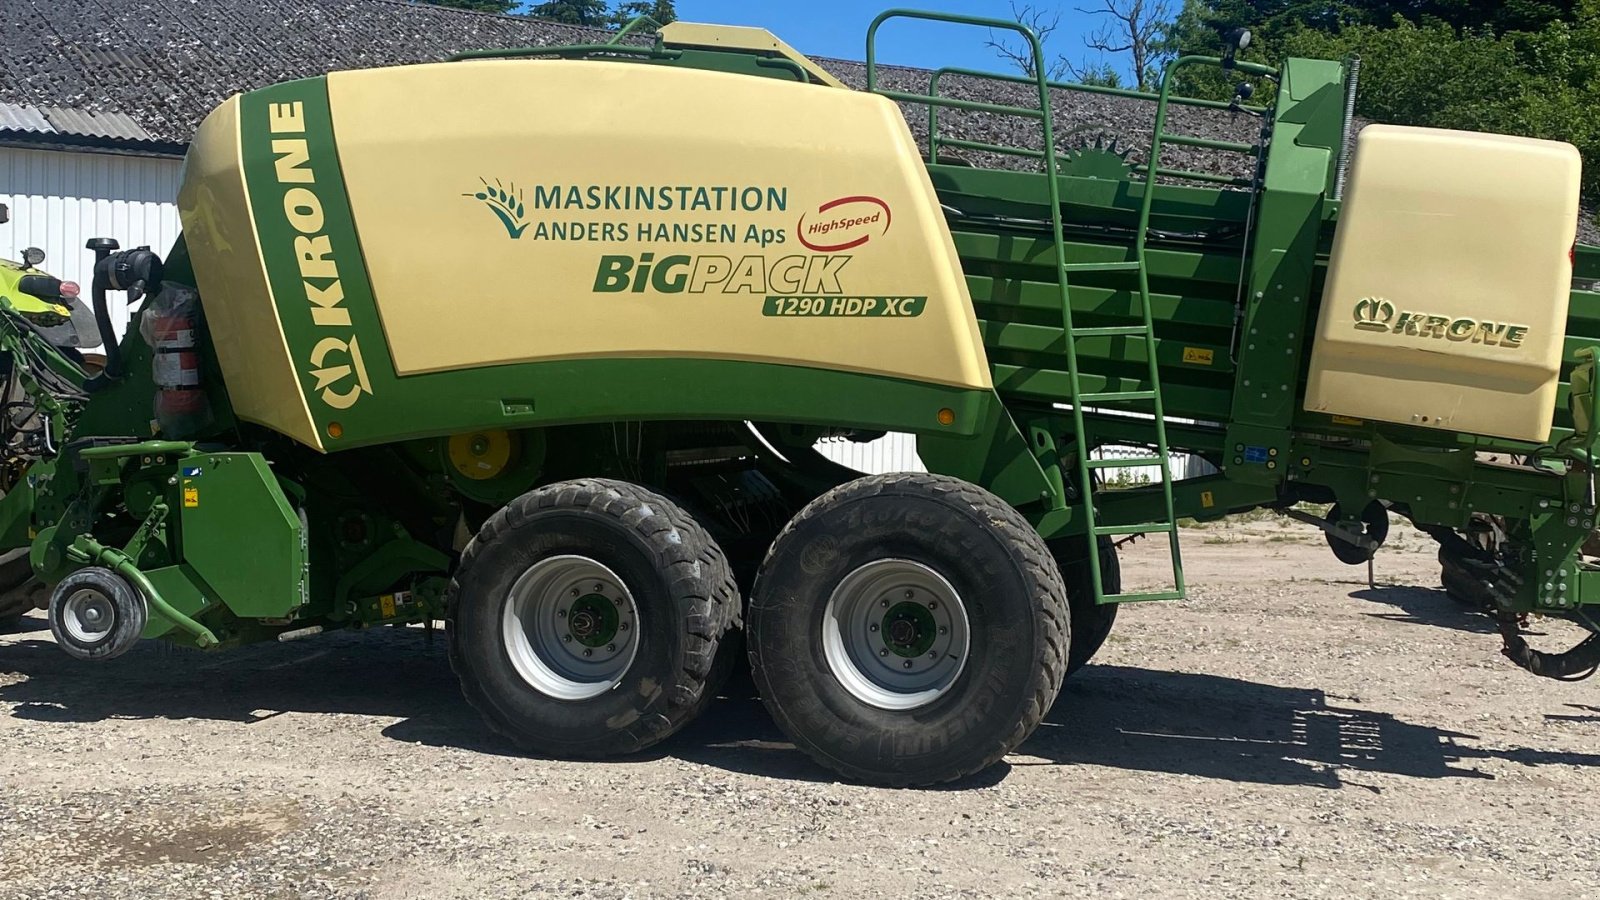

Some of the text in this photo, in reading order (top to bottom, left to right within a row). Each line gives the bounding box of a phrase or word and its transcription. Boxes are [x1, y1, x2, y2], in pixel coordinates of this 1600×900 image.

[534, 185, 787, 212] MASKINSTATION
[269, 101, 353, 326] KRONE
[808, 211, 880, 236] HighSpeed
[533, 221, 786, 248] ANDERS HANSEN Aps
[775, 298, 915, 315] 1290 HDP XC
[1392, 311, 1529, 349] KRONE
